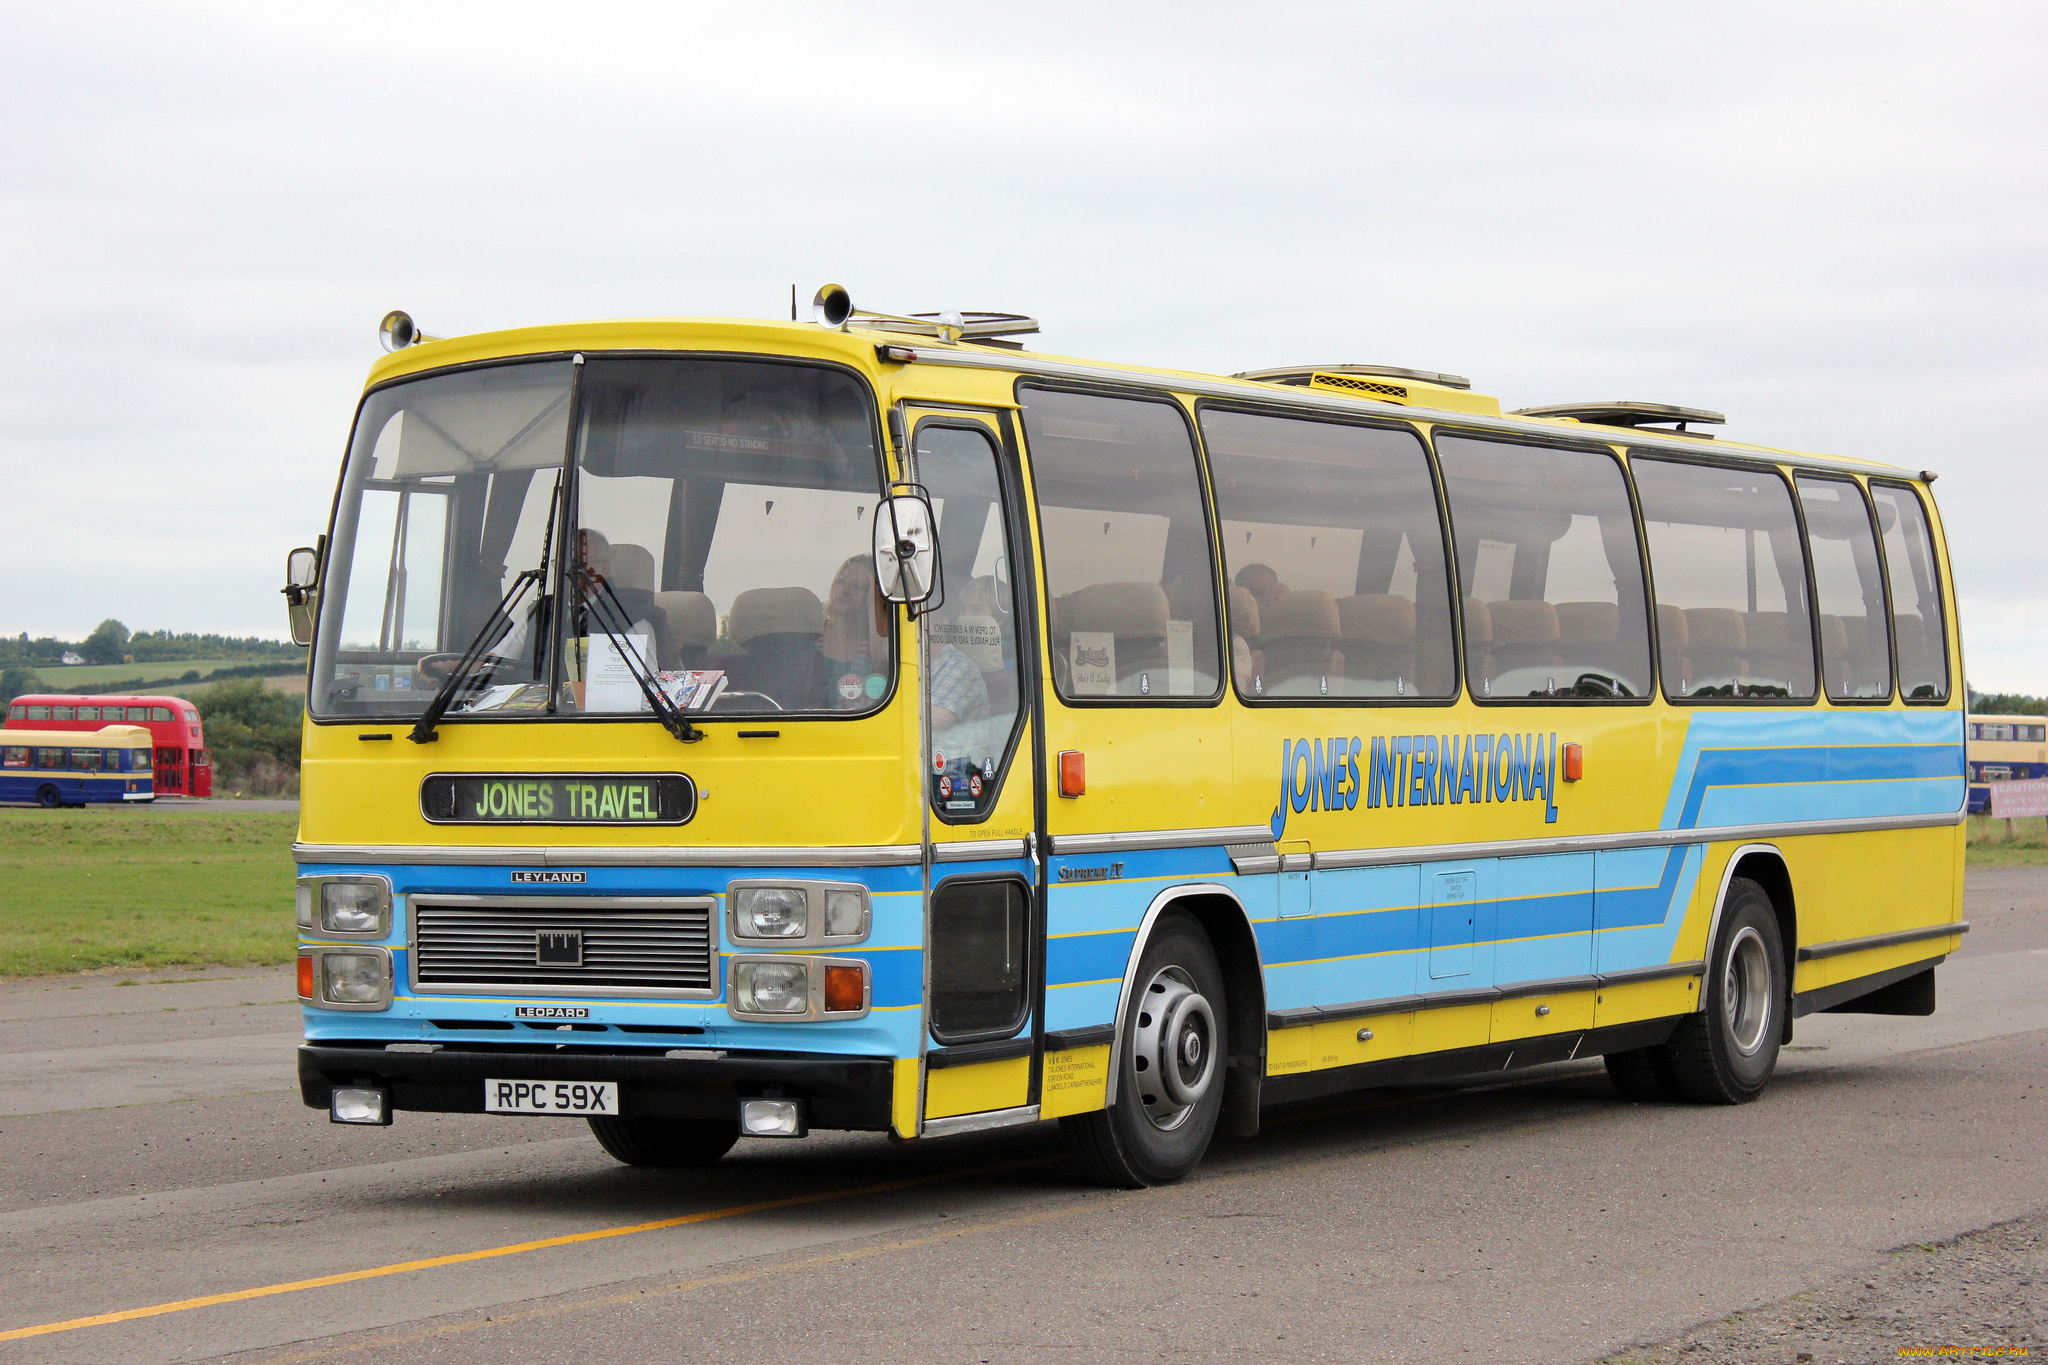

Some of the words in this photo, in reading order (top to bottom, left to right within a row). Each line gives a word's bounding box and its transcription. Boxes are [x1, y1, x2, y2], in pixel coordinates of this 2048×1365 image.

[703, 435, 727, 447] SEATED
[728, 437, 738, 448] NO
[740, 439, 769, 450] STANDING
[1271, 736, 1362, 842] JONES
[1367, 732, 1558, 823] INTERNATIONAL
[476, 783, 554, 817] JONES
[566, 784, 658, 819] TRAVEL
[970, 830, 976, 838] TO
[977, 829, 991, 837] OPEN
[992, 829, 1003, 837] PULL
[1004, 828, 1023, 836] HANDLE
[515, 873, 582, 882] LEYLAND
[1058, 865, 1108, 883] SUPREME
[518, 1008, 586, 1018] LEOPARD
[1061, 1055, 1073, 1063] JONES
[1055, 1064, 1067, 1073] JONES
[1067, 1062, 1095, 1071] INTERNATIONAL
[1047, 1074, 1063, 1082] STATION
[1063, 1073, 1075, 1081] ROAD
[497, 1082, 547, 1109] RPC
[554, 1084, 606, 1111] 59X
